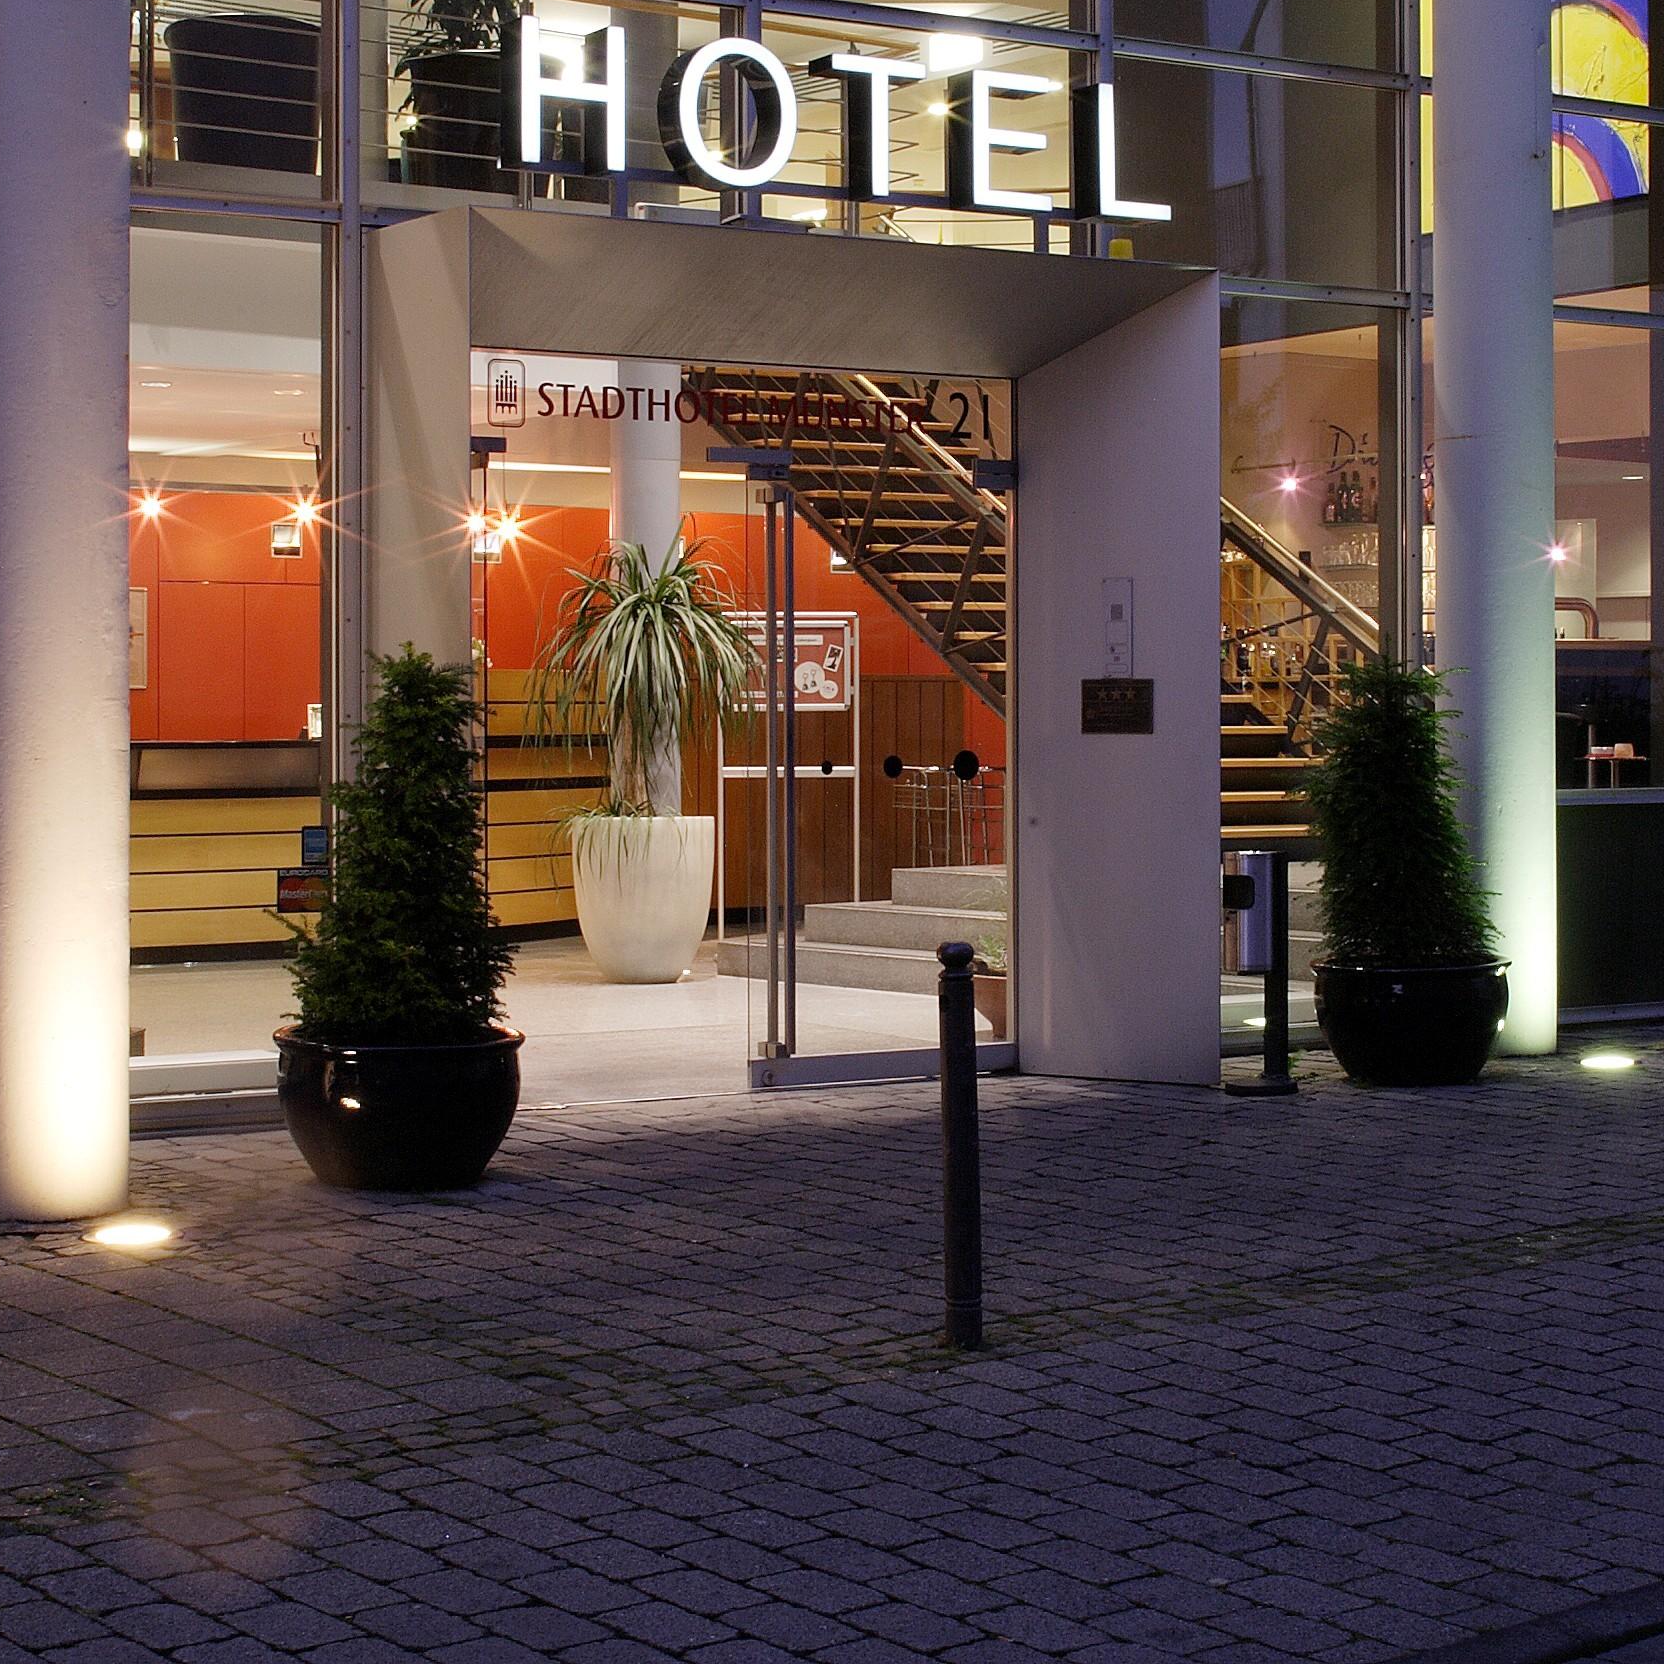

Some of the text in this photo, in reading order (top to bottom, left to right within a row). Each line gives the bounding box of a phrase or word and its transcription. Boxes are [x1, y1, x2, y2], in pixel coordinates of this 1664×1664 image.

[519, 14, 1173, 223] HOTEL
[536, 381, 761, 427] STADTHOTEL
[948, 391, 991, 441] 21
